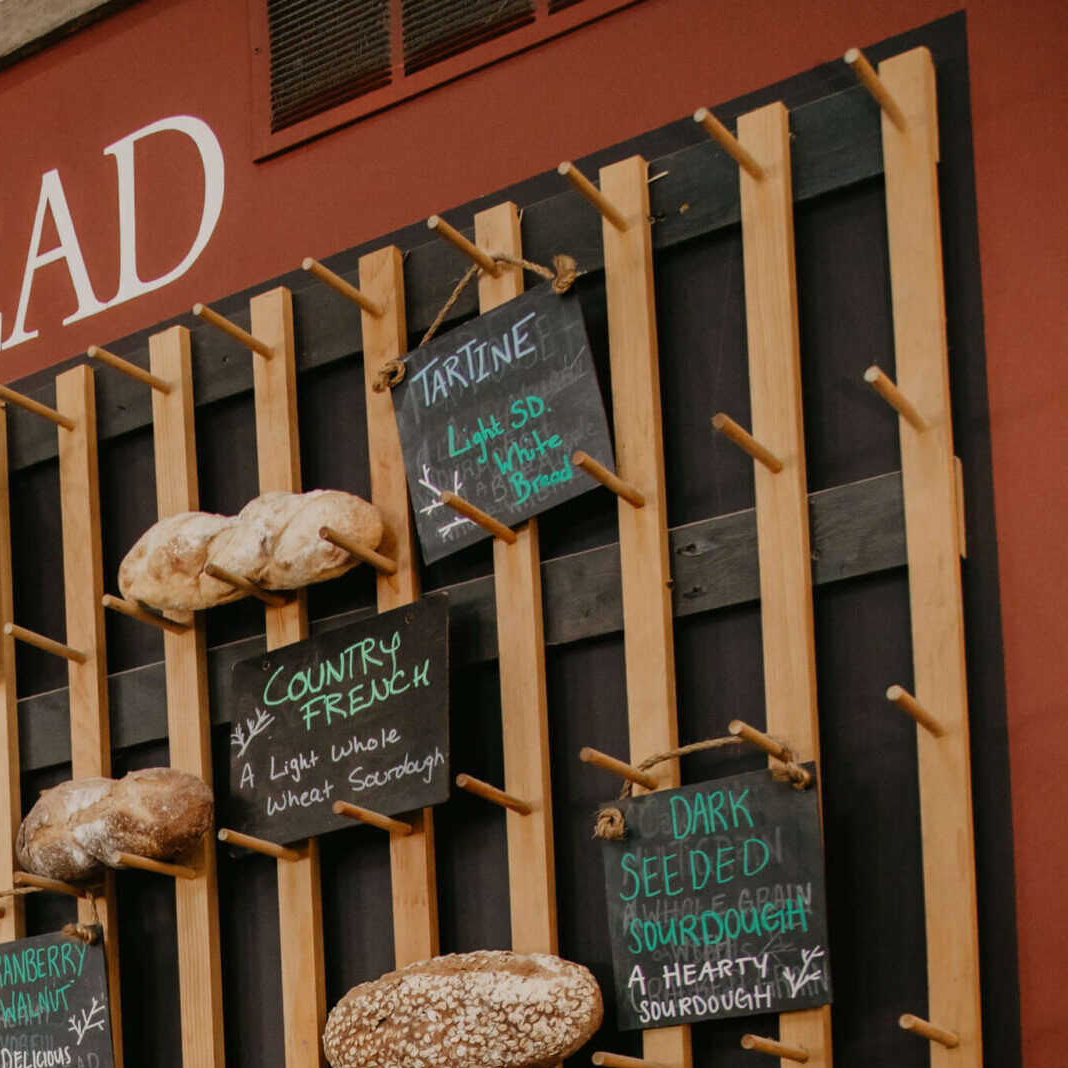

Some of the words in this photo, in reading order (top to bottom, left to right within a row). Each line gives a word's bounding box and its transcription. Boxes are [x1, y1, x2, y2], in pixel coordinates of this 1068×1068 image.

[411, 312, 536, 408] TARTINE
[447, 413, 504, 465] Light
[493, 429, 564, 475] White
[509, 454, 574, 506] Bread
[263, 631, 402, 706] COUNTRY
[299, 659, 430, 731] FRENCH
[239, 762, 255, 789] A
[270, 750, 319, 783] Light
[348, 746, 445, 791] Sourdough
[669, 788, 755, 840] DARK
[619, 838, 770, 901] SEEDED
[628, 894, 809, 954] SOURDOUGH
[627, 964, 646, 996] A
[663, 952, 769, 990] HEARTY
[639, 984, 773, 1024] SOURDOUGH
